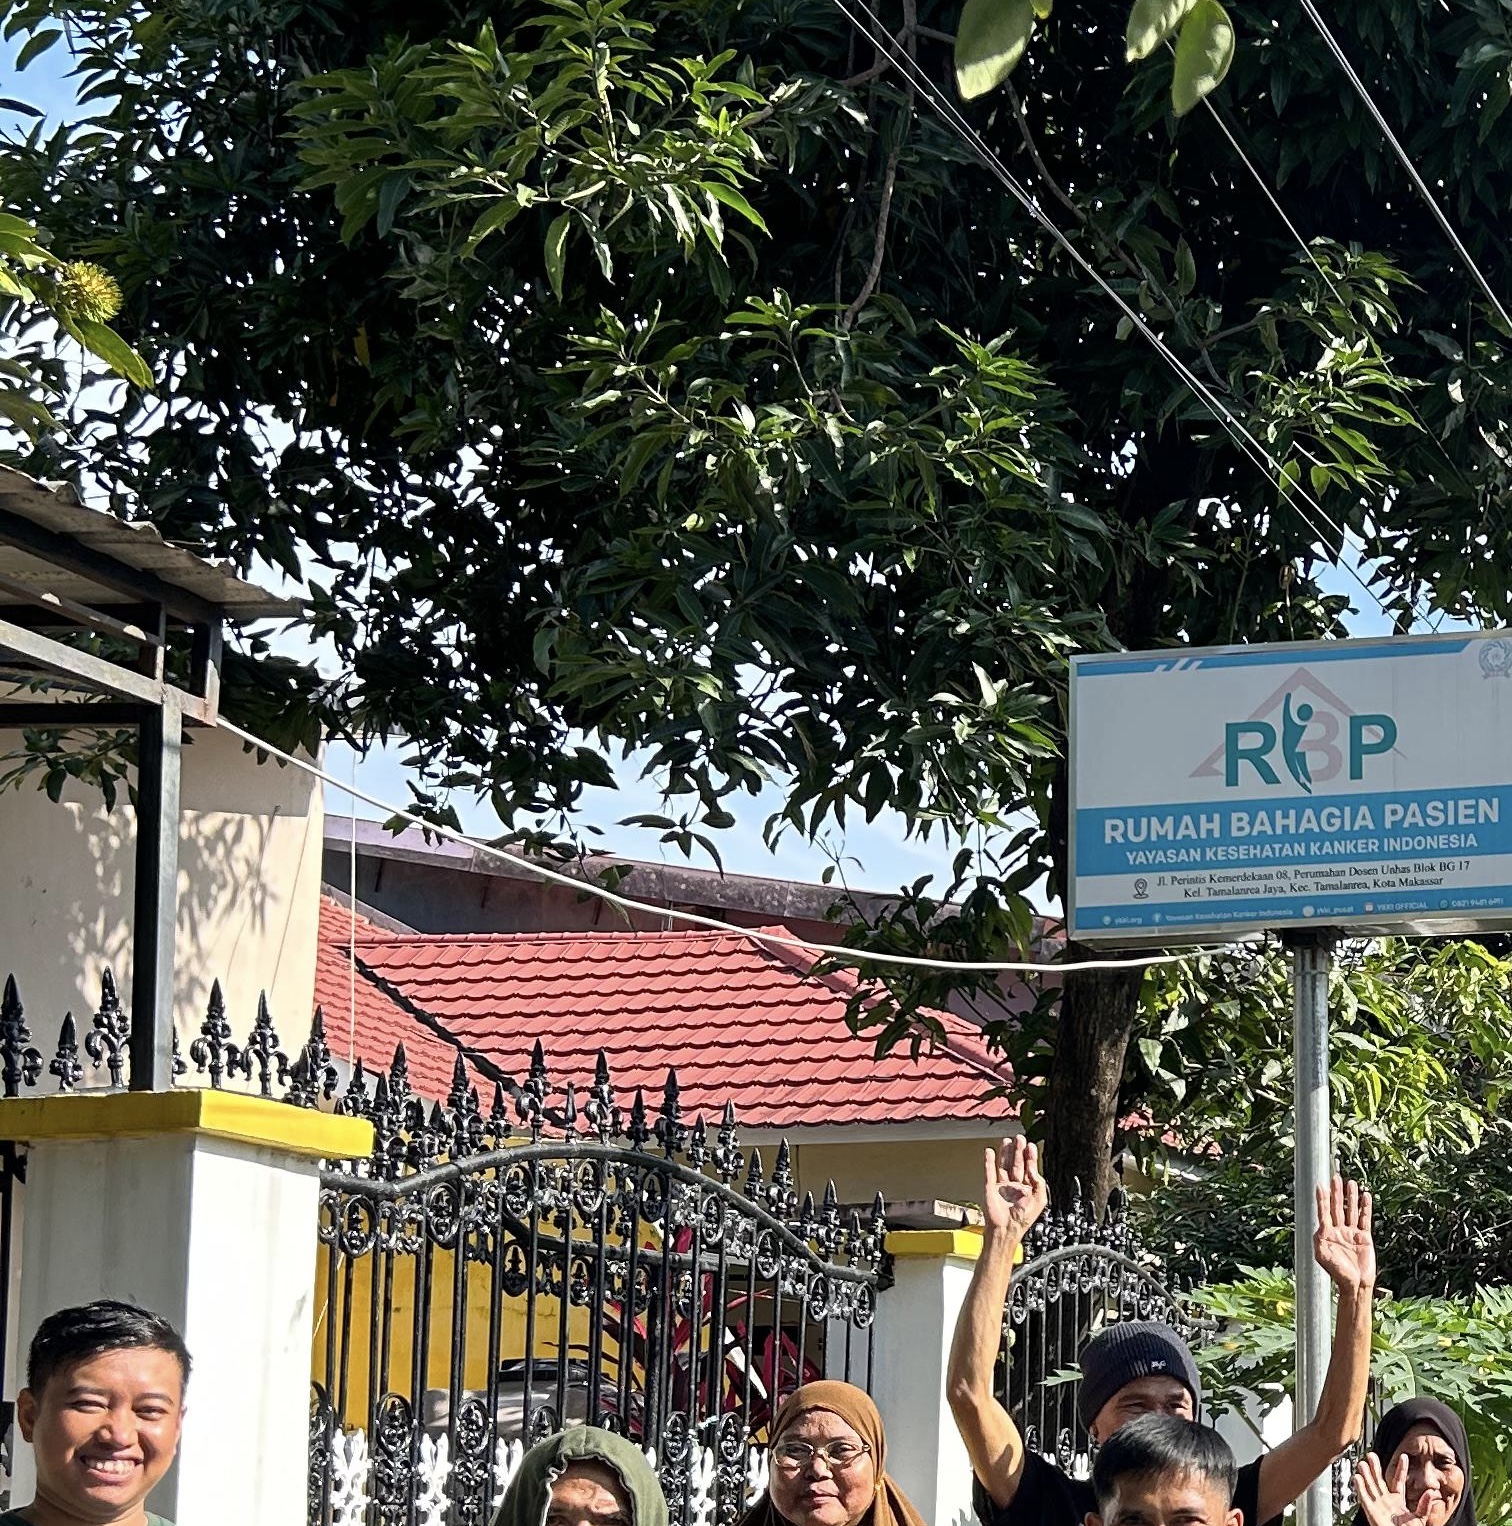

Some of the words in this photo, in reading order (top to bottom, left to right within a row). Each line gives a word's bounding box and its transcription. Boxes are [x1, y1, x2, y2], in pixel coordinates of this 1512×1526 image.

[1225, 703, 1397, 791] RBP
[1104, 813, 1220, 844] RUMAH
[1231, 806, 1375, 836] BAHAGIA
[1384, 797, 1500, 829] PASIEN
[1126, 848, 1201, 866] YAYASAN
[1205, 842, 1306, 861] KESEHATAN
[1310, 838, 1379, 856] KANKER
[1383, 833, 1478, 852] INDONESIA
[1156, 876, 1168, 887] Jl.
[1171, 874, 1207, 886] Perintis
[1209, 870, 1274, 884] Kemerdekaan
[1276, 870, 1291, 882] 08,
[1293, 867, 1346, 880] Perumahan
[1349, 865, 1379, 877] Dosen
[1381, 863, 1411, 875] Unhas
[1413, 861, 1436, 873] Blok
[1439, 861, 1456, 872] BG
[1459, 861, 1470, 871] 17
[1207, 883, 1260, 897] Tamalanrea
[1263, 882, 1287, 895] Jaya,
[1290, 880, 1310, 892] Kec.
[1314, 877, 1370, 891] Tamalanrea,
[1373, 877, 1396, 888] Kota
[1399, 873, 1444, 887] Makassar
